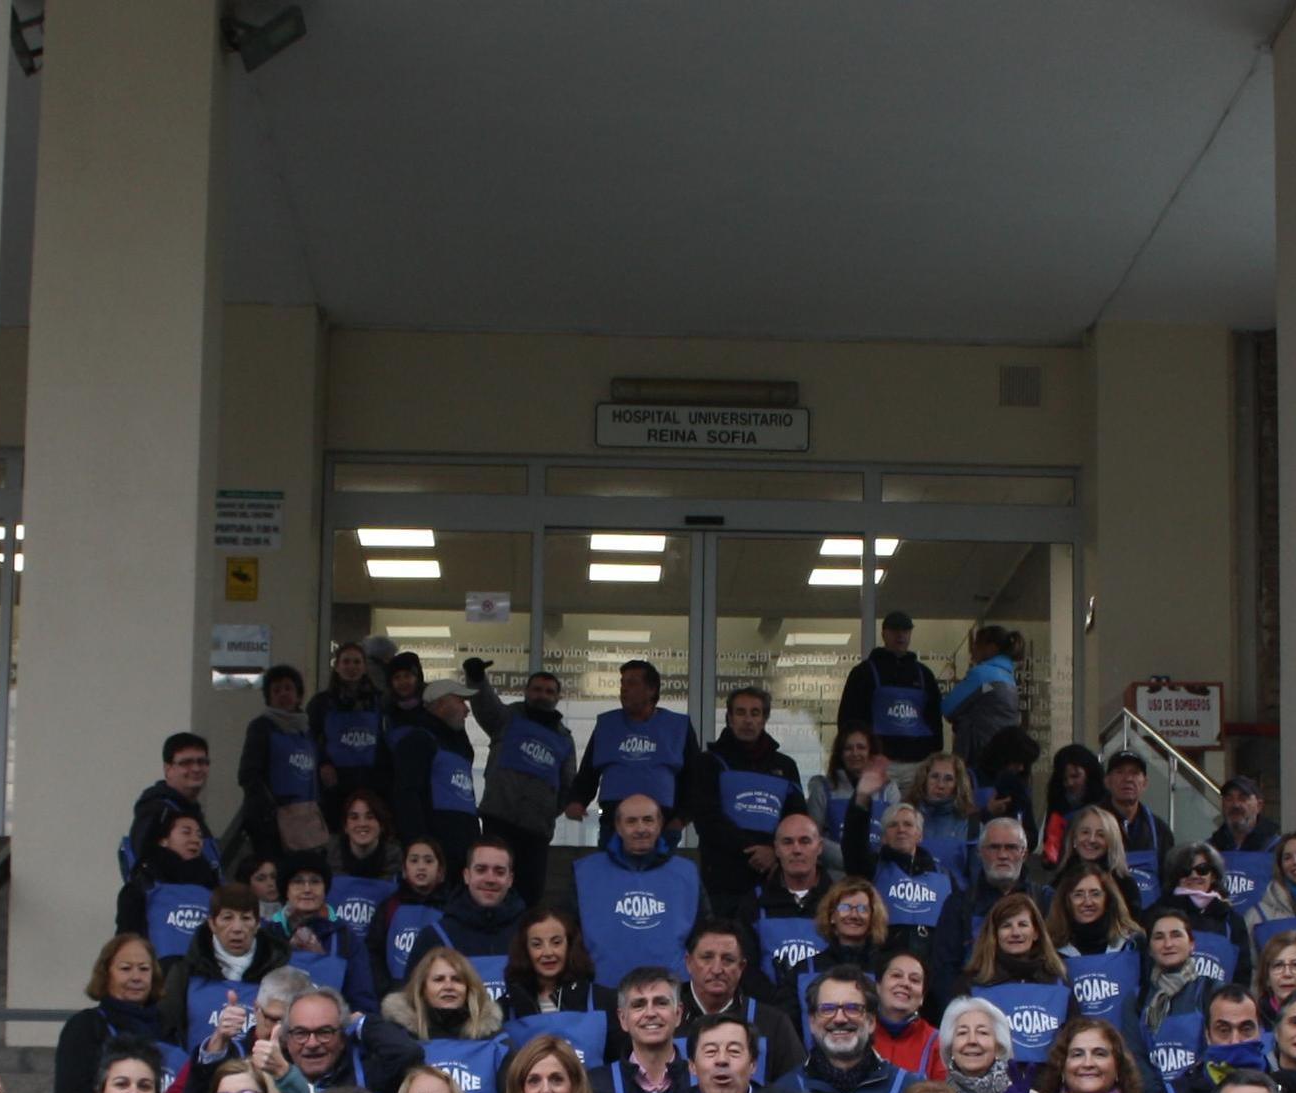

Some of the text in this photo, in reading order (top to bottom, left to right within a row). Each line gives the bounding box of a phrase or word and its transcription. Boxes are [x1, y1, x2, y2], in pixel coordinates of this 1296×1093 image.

[612, 409, 794, 428] HOSPITAL UNIVERSITARIO
[646, 428, 758, 445] REINA SOFIA
[1159, 718, 1201, 727] ESCALERA
[888, 879, 937, 904] ACOARE
[615, 896, 666, 919] ACOARE
[1074, 979, 1120, 1003] COARE
